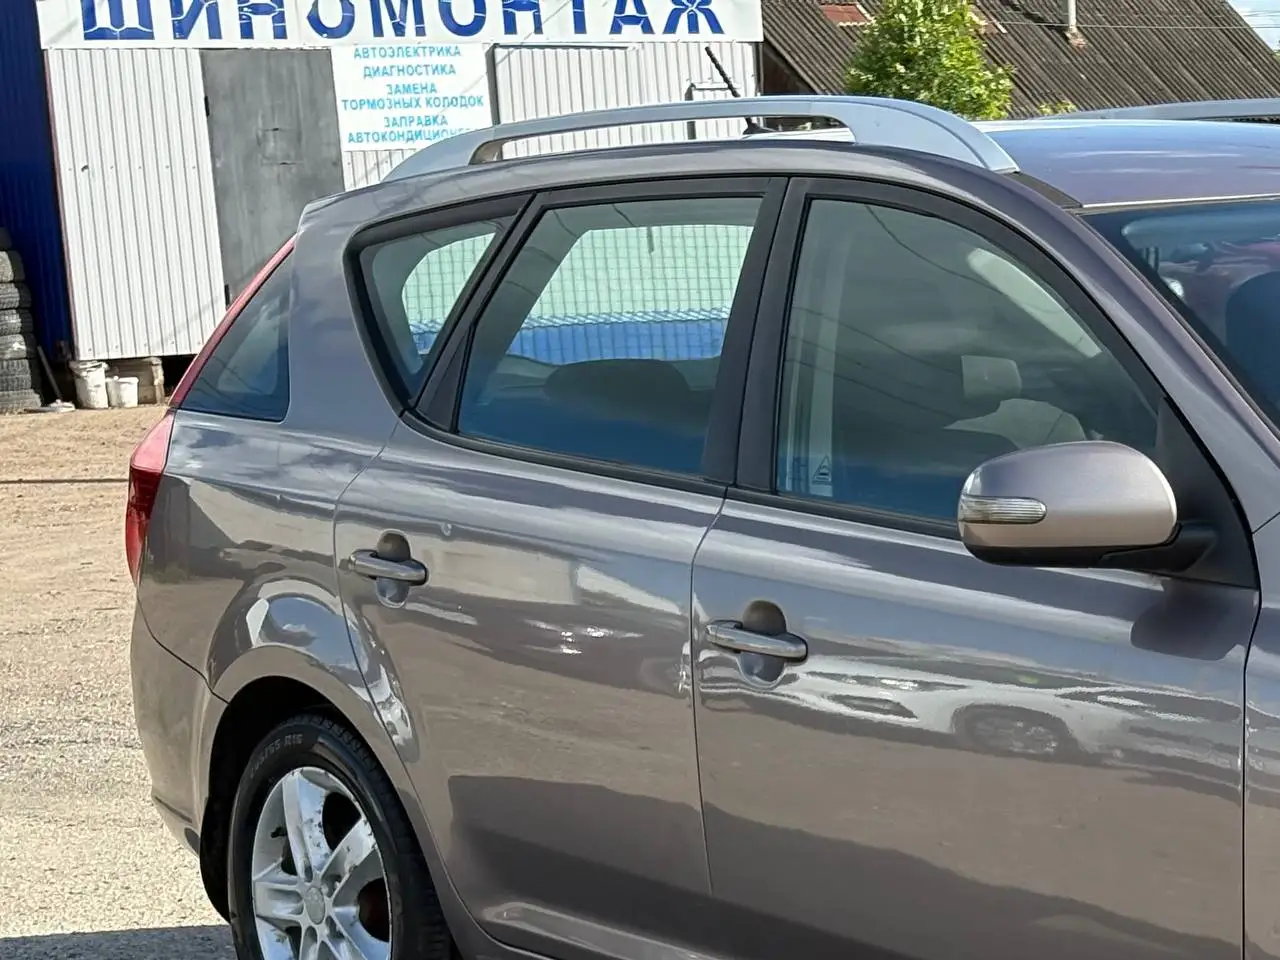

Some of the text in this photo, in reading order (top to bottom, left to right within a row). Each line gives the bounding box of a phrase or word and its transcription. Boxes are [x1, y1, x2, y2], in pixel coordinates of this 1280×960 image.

[80, 0, 725, 40] ШИНОМОНТАЖ
[353, 46, 461, 59] АВТОЭЛЕКТРИКА
[363, 64, 456, 79] ДИАГНОСТИКА
[386, 82, 437, 96] ЗАМЕНА
[341, 95, 484, 111] ТОРМОЗНЫХ КОЛОДОК
[384, 115, 448, 128] ЗАПРАВКА
